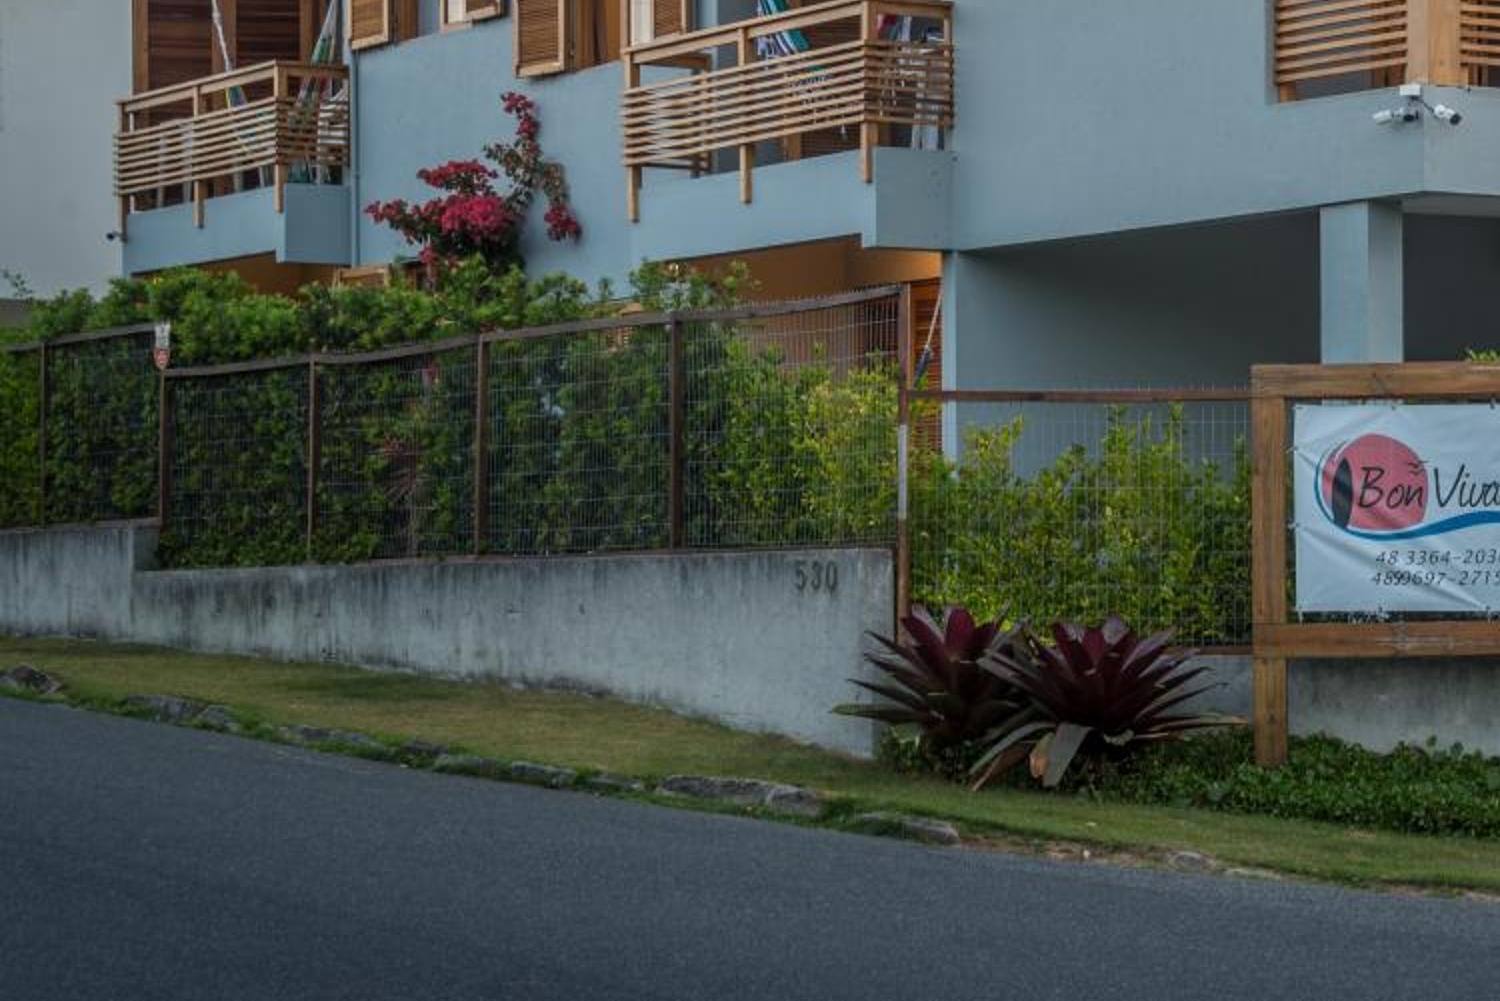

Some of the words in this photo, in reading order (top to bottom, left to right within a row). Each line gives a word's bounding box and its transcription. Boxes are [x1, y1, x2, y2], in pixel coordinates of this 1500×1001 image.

[1358, 466, 1425, 508] Bon
[1375, 550, 1399, 566] 48
[794, 560, 838, 592] 530
